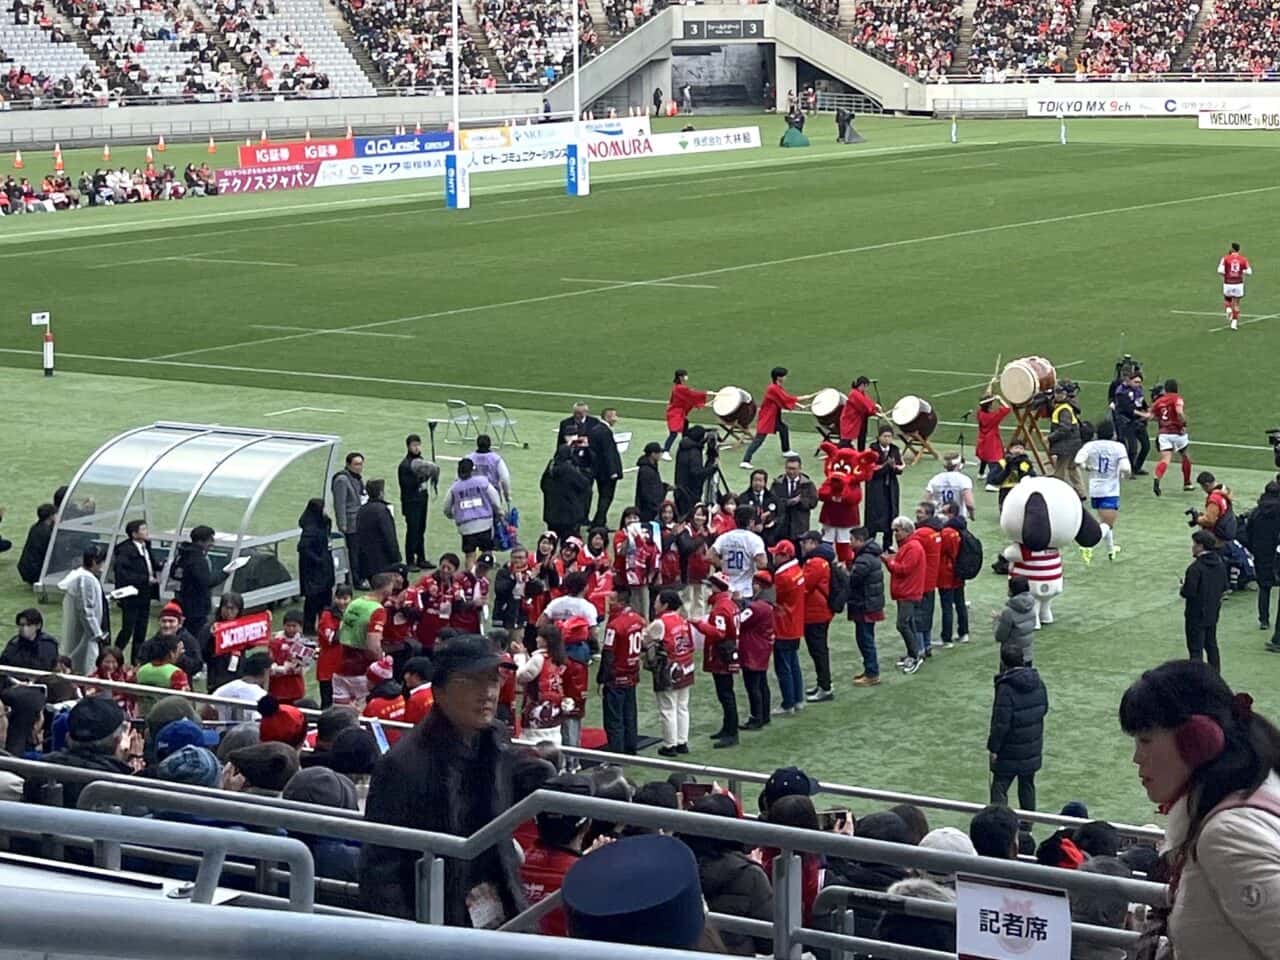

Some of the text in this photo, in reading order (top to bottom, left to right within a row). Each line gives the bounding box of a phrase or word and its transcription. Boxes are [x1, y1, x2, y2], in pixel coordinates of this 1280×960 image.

[690, 24, 698, 35] 3
[750, 23, 757, 34] 3
[1036, 100, 1132, 113] TOKYO MX 9ch
[1209, 114, 1252, 127] WELCOME
[588, 138, 653, 158] NOMURA
[218, 172, 315, 191] テクノスジャパン
[728, 550, 743, 570] 20
[628, 632, 642, 655] 10
[979, 907, 1049, 942] 記者席
